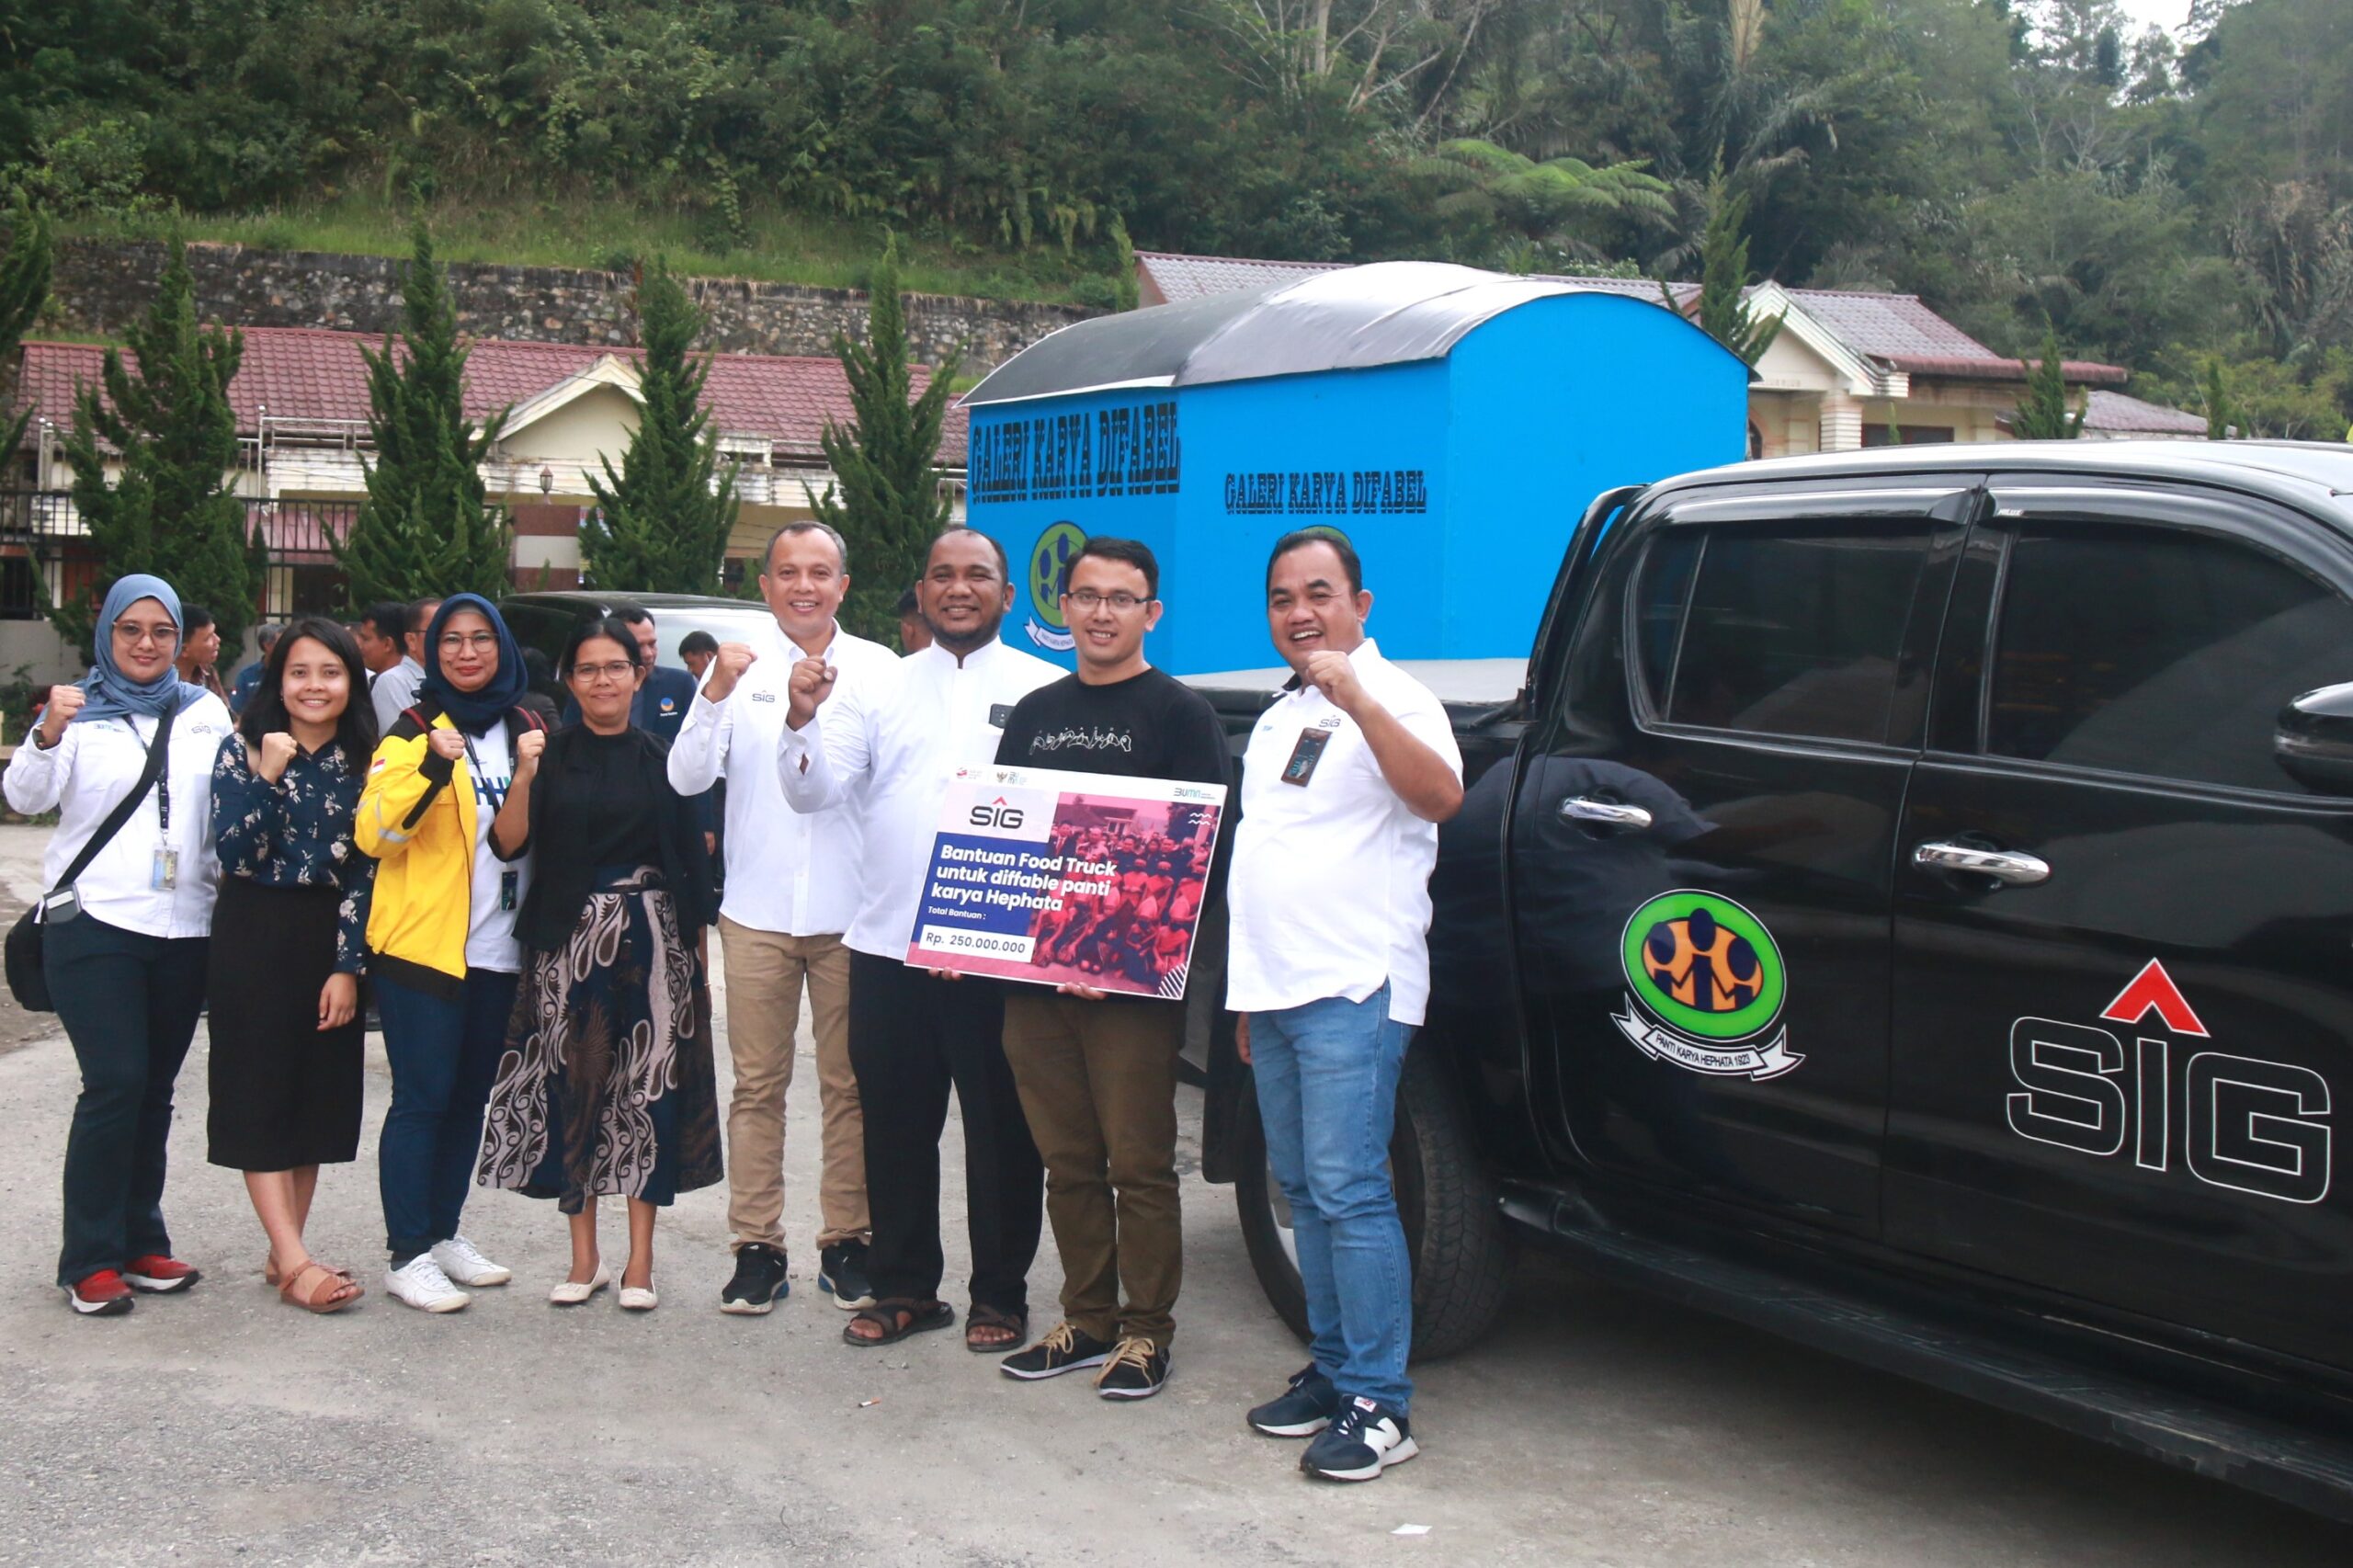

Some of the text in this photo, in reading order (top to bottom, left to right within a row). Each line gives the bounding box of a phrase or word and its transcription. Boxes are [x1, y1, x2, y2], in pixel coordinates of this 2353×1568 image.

[972, 402, 1181, 505] GALERI KARYA DIFABEL
[1224, 470, 1427, 515] GALERI KARYA DIFABEL
[752, 693, 776, 703] SIG
[970, 805, 1025, 829] SIG
[940, 844, 1118, 877] Bantuan Food Truck
[931, 882, 1063, 911] karya Hephata
[937, 866, 1112, 897] untuk diffable panti
[927, 905, 948, 915] Total
[926, 932, 1026, 954] Rp. 250.000.000
[1655, 1033, 1751, 1067] PANTI KARYA HEPHATA 1923
[2007, 1016, 2331, 1204] SIG
